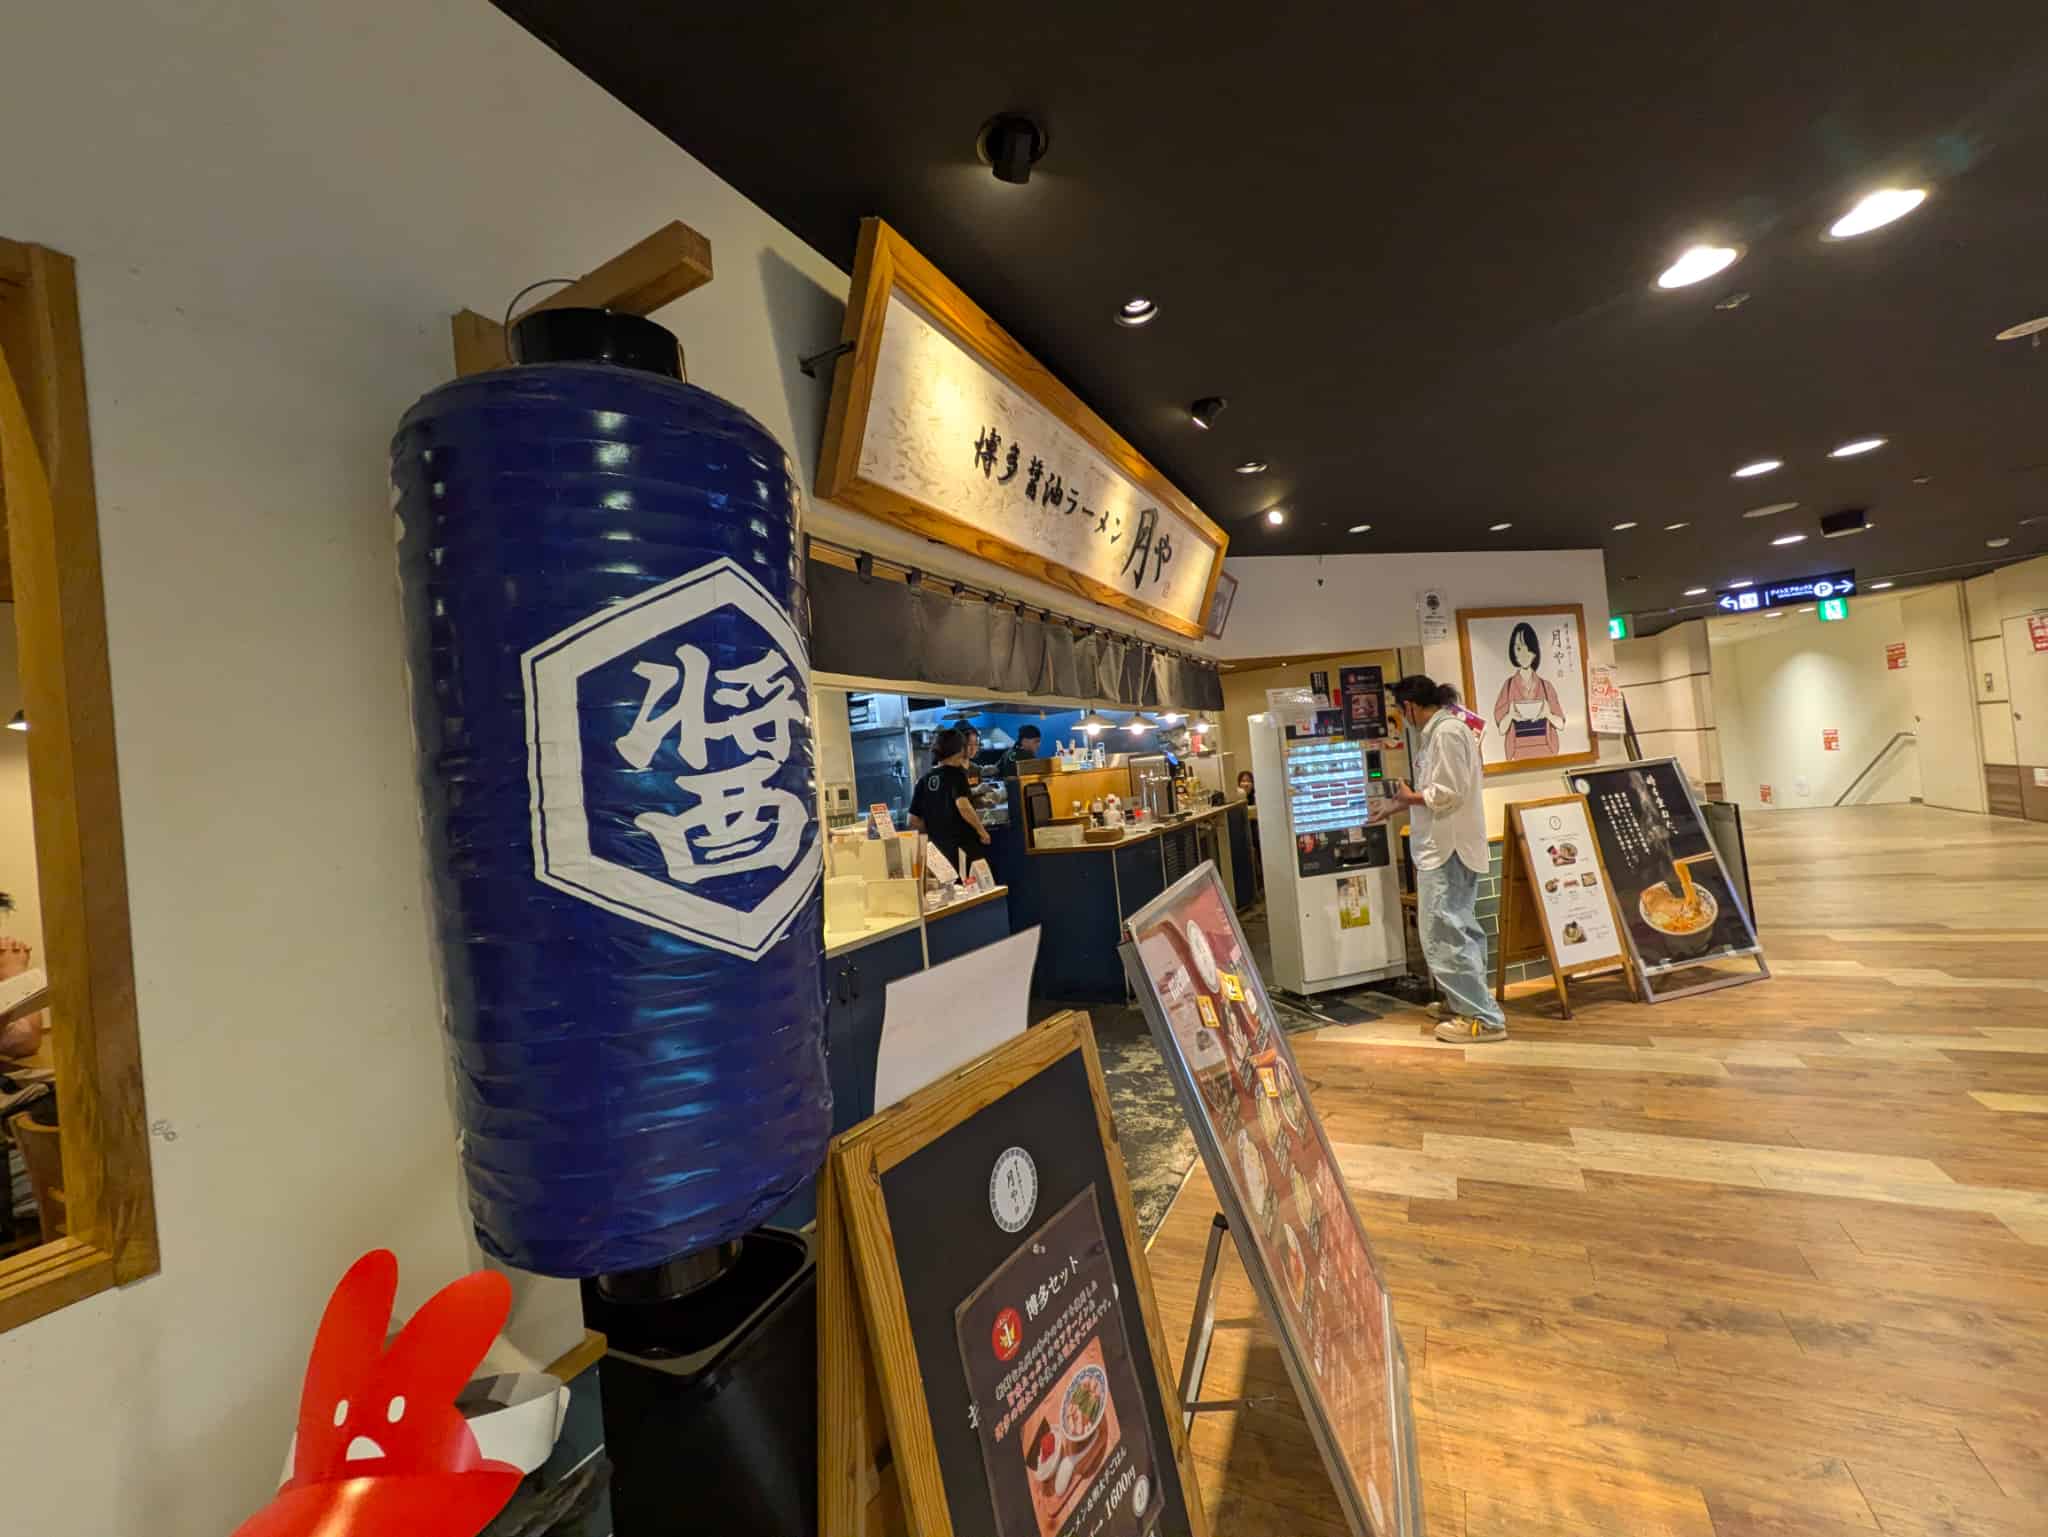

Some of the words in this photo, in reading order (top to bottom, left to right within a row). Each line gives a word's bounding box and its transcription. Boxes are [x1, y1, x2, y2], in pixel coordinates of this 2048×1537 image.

[974, 425, 1122, 545] 博多醤油ラーメン
[1121, 507, 1172, 589] 月や
[1551, 629, 1565, 665] 月や
[1025, 1254, 1080, 1322] 博多セット
